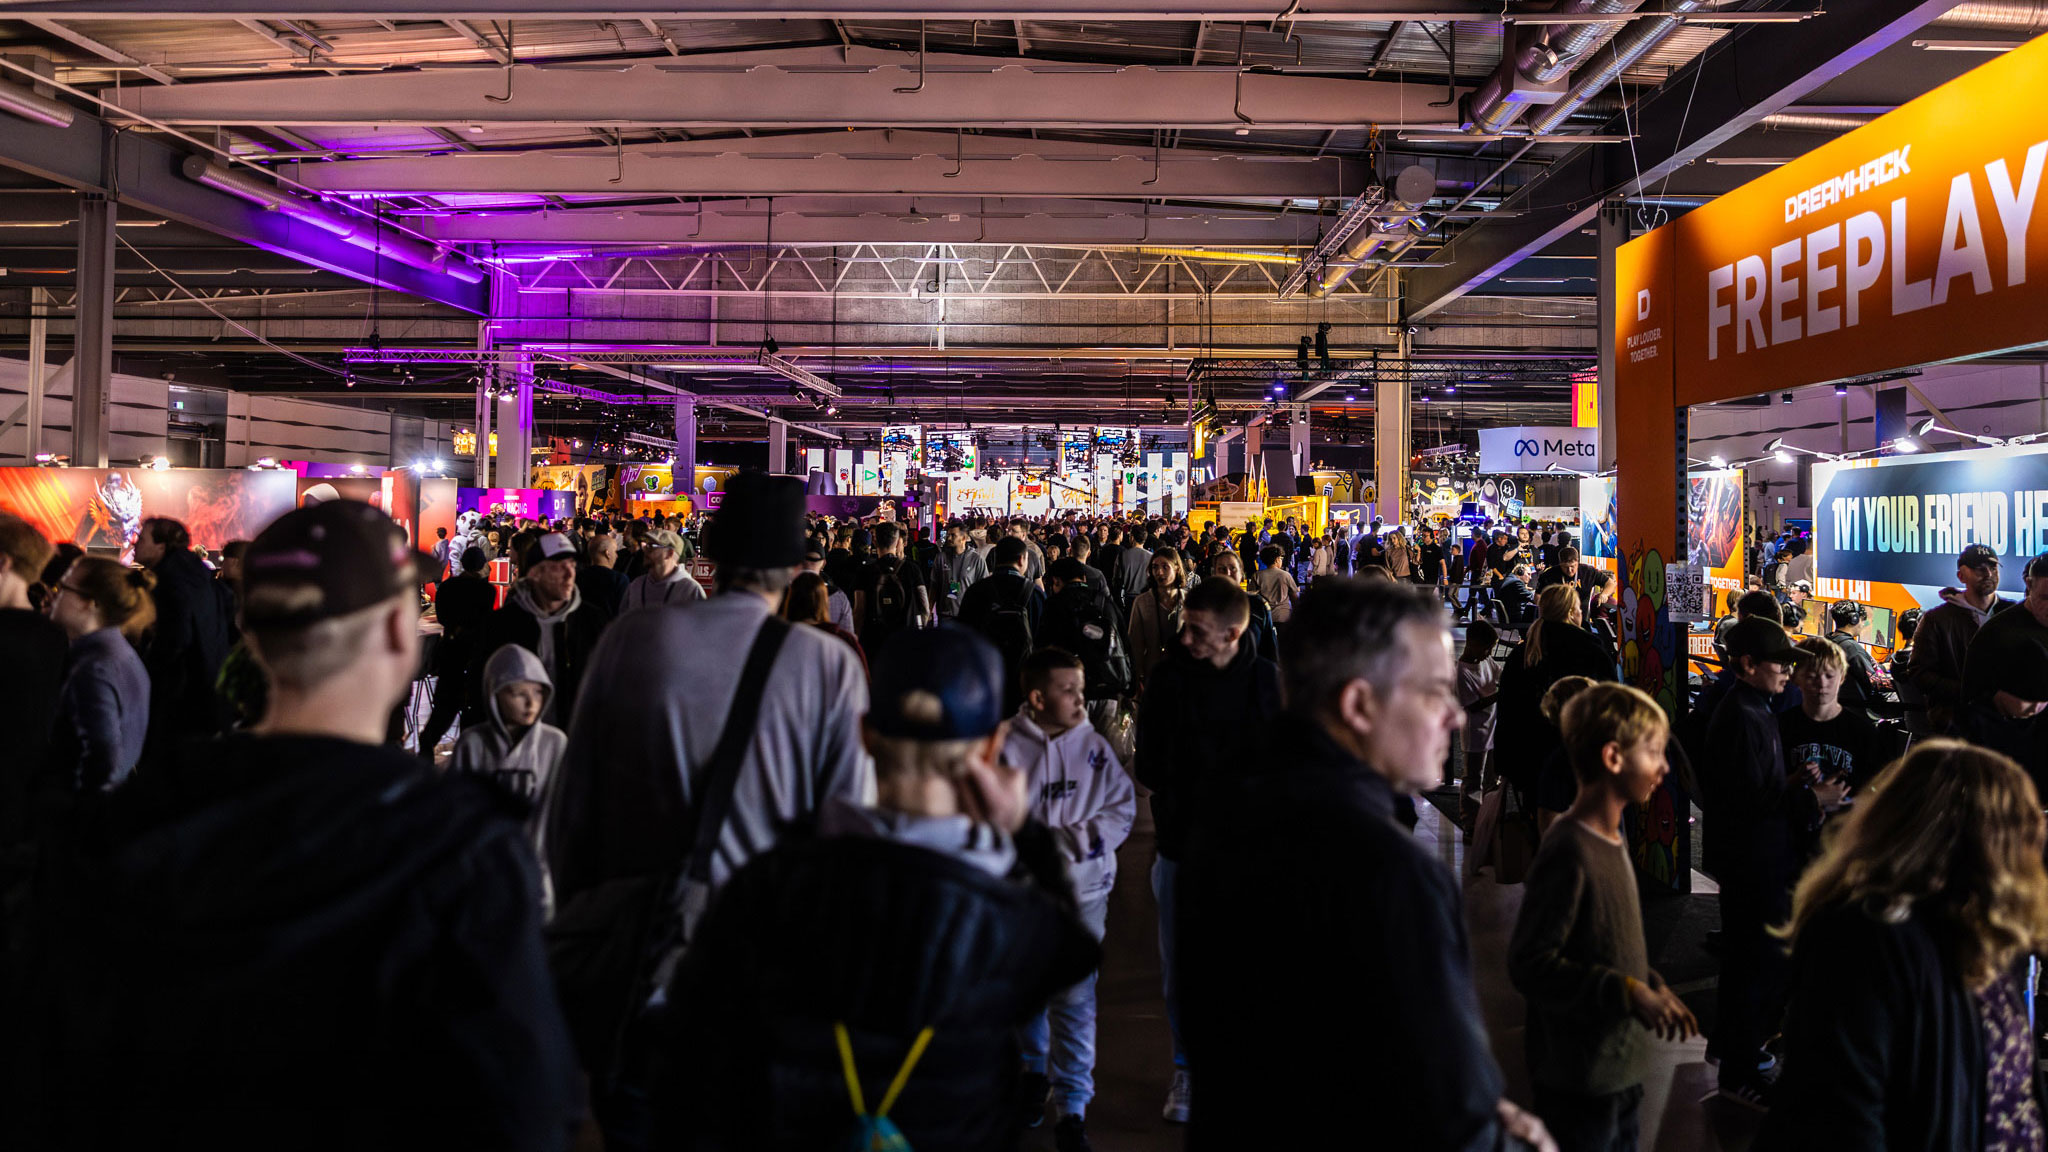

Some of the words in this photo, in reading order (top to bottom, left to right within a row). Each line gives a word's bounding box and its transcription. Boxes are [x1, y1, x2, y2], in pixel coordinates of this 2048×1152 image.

[1785, 144, 1911, 223] DREAMHACK
[1708, 140, 2048, 361] FREEPLAY
[1638, 288, 1651, 321] D
[1627, 333, 1640, 349] PLAY
[1544, 439, 1595, 456] Meta
[1831, 496, 1860, 551] 1V1
[1864, 495, 1919, 554] YOUR
[1924, 491, 2008, 556] FRIEND
[1791, 742, 1854, 773] STRVE
